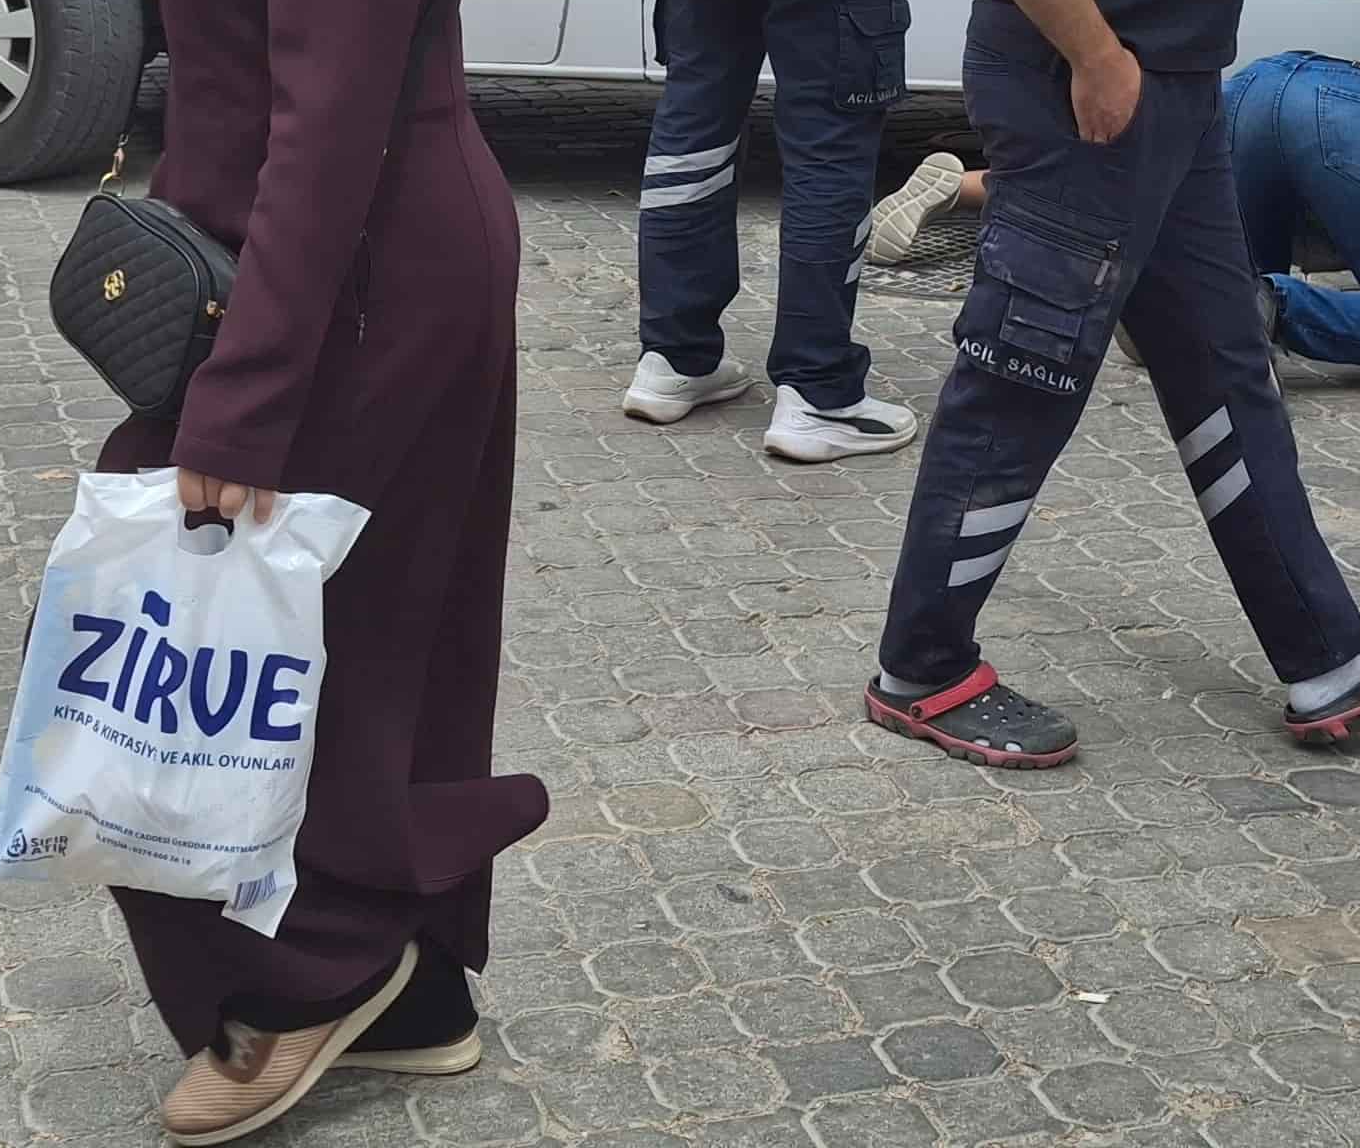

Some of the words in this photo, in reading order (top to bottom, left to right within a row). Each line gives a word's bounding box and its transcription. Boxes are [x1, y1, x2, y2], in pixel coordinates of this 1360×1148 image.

[57, 590, 312, 742] ZİRVE
[54, 705, 94, 726] KİTAP
[160, 751, 179, 765] VE
[180, 752, 214, 767] AKIL
[218, 754, 296, 771] OYUNLARI
